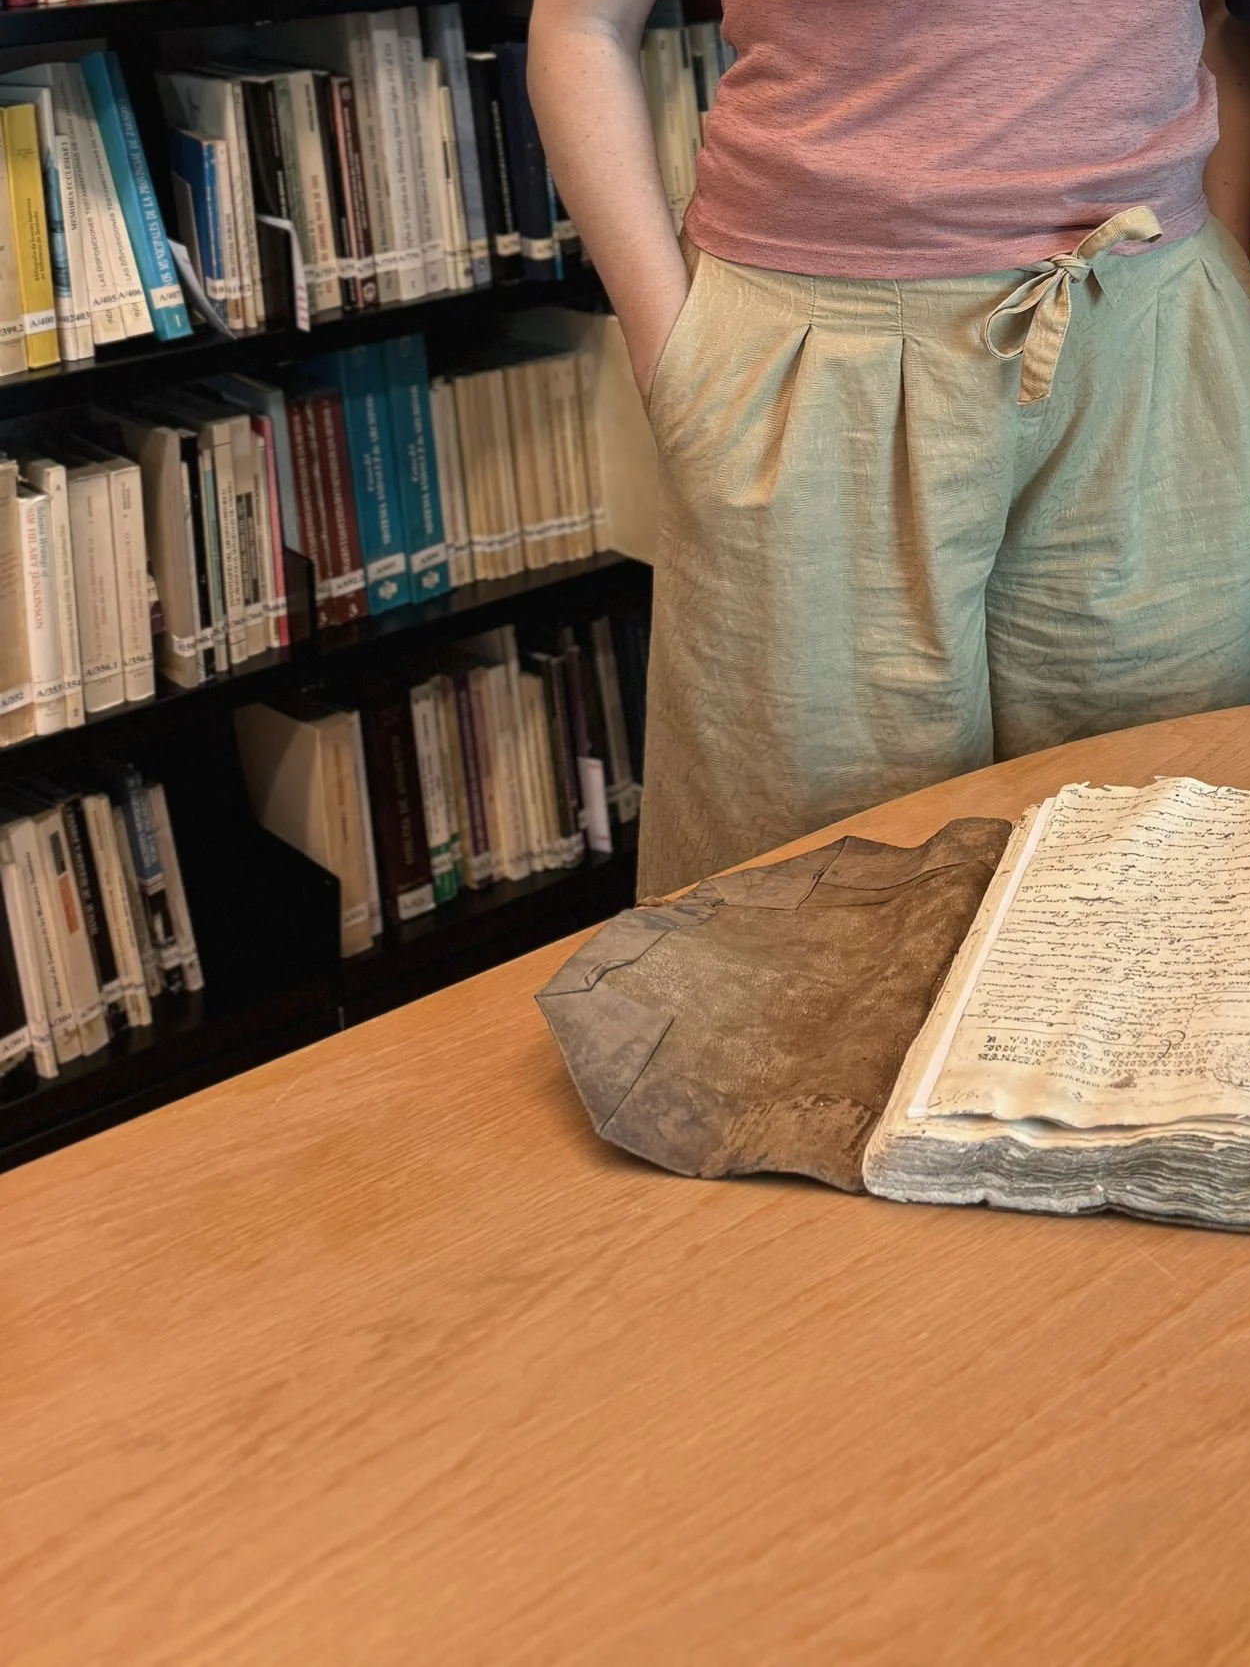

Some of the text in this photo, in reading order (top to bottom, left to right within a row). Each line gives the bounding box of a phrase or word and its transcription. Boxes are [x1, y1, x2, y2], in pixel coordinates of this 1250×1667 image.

[93, 294, 117, 306] A/405
[118, 288, 142, 300] A/406
[27, 524, 38, 565] HILARY
[31, 568, 44, 630] JENKINSON
